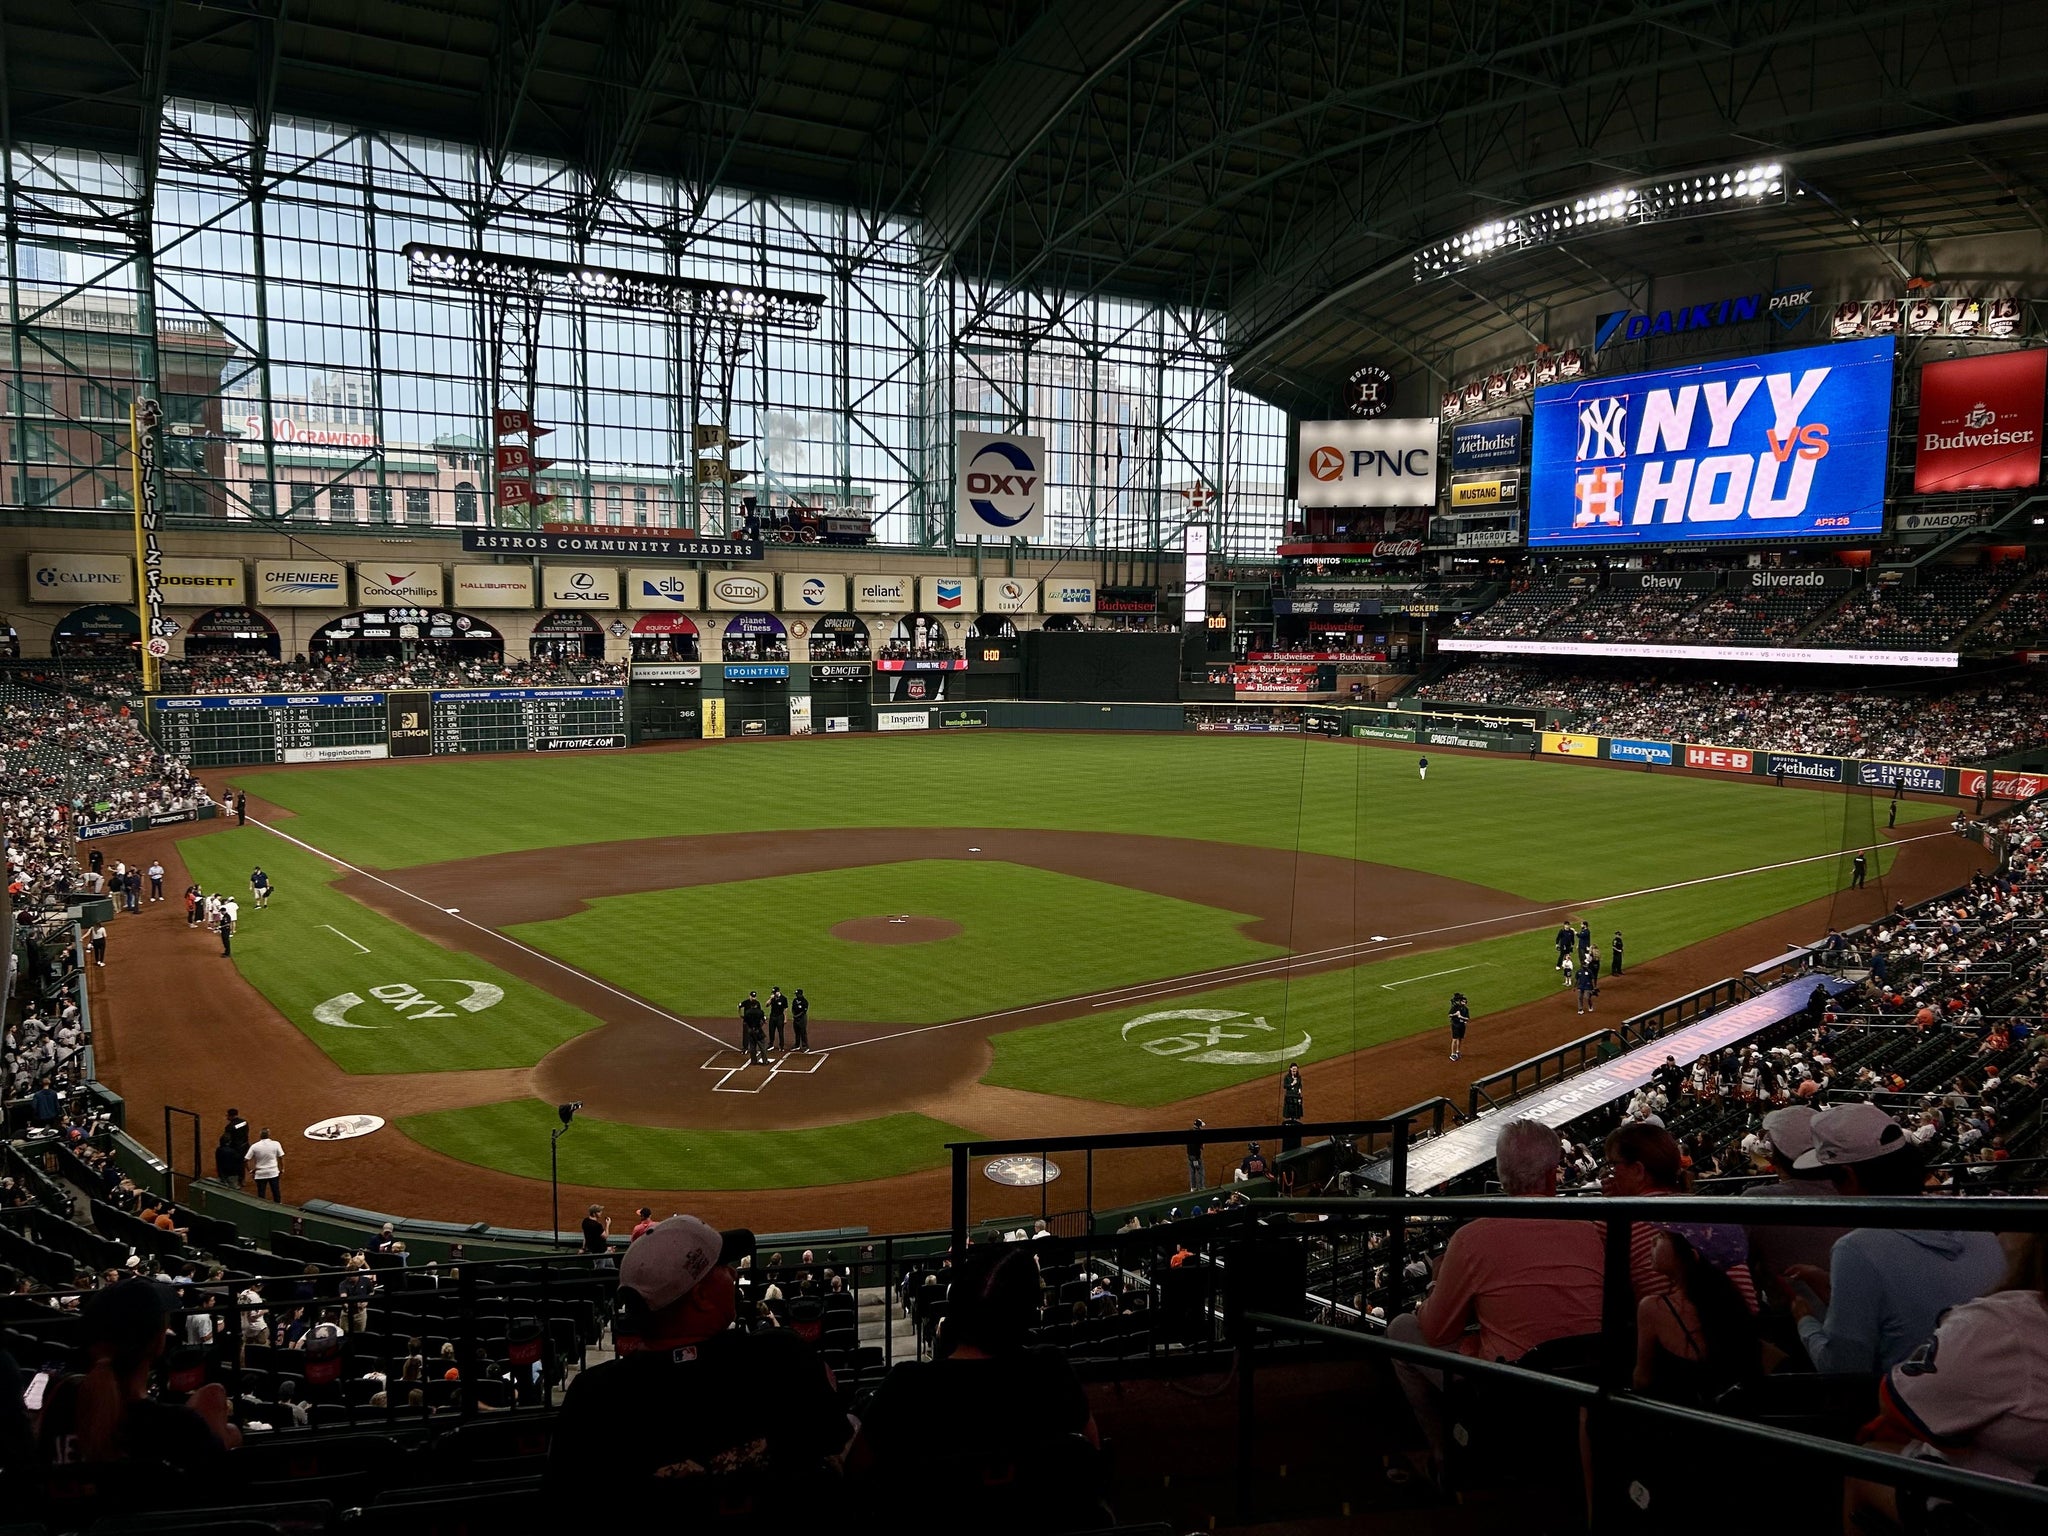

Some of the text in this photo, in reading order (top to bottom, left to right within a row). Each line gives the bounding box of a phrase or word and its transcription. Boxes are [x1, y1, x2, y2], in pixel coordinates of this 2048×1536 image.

[1625, 290, 1813, 341] DAIKIN PARK
[1835, 301, 1859, 321] 49
[1871, 300, 1896, 320] 24
[1915, 299, 1929, 319] 5
[1957, 299, 1969, 319] 7
[1991, 299, 2018, 319] 13
[1350, 366, 1390, 383] HOUSTON
[1350, 402, 1388, 416] ASTROS
[1635, 367, 1833, 455] NYY
[503, 416, 522, 430] 05
[703, 430, 719, 443] 17
[1457, 434, 1481, 442] HOUSTON
[1766, 424, 1829, 462] VS
[1924, 429, 2031, 451] Budweiser
[1457, 434, 1516, 454] Methodist
[504, 451, 523, 465] 19
[1351, 449, 1429, 478] PNC
[704, 465, 720, 476] 22
[141, 435, 157, 531] CHIKIN
[966, 473, 1037, 496] OXY
[1633, 449, 1821, 525] HOU
[504, 485, 522, 498] 21
[1460, 486, 1516, 500] MUSTANG CAT
[1815, 517, 1850, 526] APR 26
[1923, 514, 1977, 527] NABORS
[563, 525, 670, 536] DAIKIN PARK
[476, 536, 752, 555] ASTROS COMMUNITY LEADERS
[1466, 532, 1511, 546] HARGROVE
[60, 573, 122, 584] CALPINE
[158, 576, 235, 586] DOGGETT
[265, 572, 339, 583] CHENIERE
[1641, 571, 1824, 589] Chevy Silverado
[660, 577, 685, 592] slb
[720, 583, 760, 598] COTTON
[862, 585, 900, 597] reliant
[364, 586, 438, 597] ConocoPhillips
[554, 592, 609, 600] LEXUS
[1062, 588, 1091, 602] LNG
[147, 571, 164, 636] FAIR
[1097, 599, 1156, 611] Budweiser
[740, 617, 766, 626] planet
[743, 624, 771, 632] fitness
[825, 619, 857, 628] SPACE CITY
[1208, 617, 1226, 628] 0:00
[1308, 621, 1364, 631] Budweiser
[984, 650, 999, 660] 0:00
[1273, 653, 1376, 661] Budweiser Budweiser
[729, 668, 786, 676] 1POINTFIVE
[831, 666, 862, 675] EMCJET
[1256, 683, 1299, 692] Budweiser
[891, 714, 925, 725] Insperity
[1484, 721, 1498, 729] 370
[392, 729, 429, 738] BETMGM
[1366, 729, 1385, 738] National
[1431, 734, 1446, 744] SPACE
[1446, 736, 1458, 746] CITY
[548, 737, 614, 750] NITTOTIRE.COM
[319, 749, 371, 758] Higginbotham
[1621, 746, 1670, 758] HONDA
[1690, 750, 1748, 768] H-E-B
[1882, 766, 1930, 778] ENERGY
[1882, 775, 1942, 789] TRNSFER
[85, 823, 128, 836] AmegyBank
[369, 983, 458, 1020] OXY
[1141, 1016, 1277, 1056] OXY
[1608, 1005, 1778, 1082] HOUSTON ASTROS
[1518, 1078, 1615, 1121] HOME OF THE
